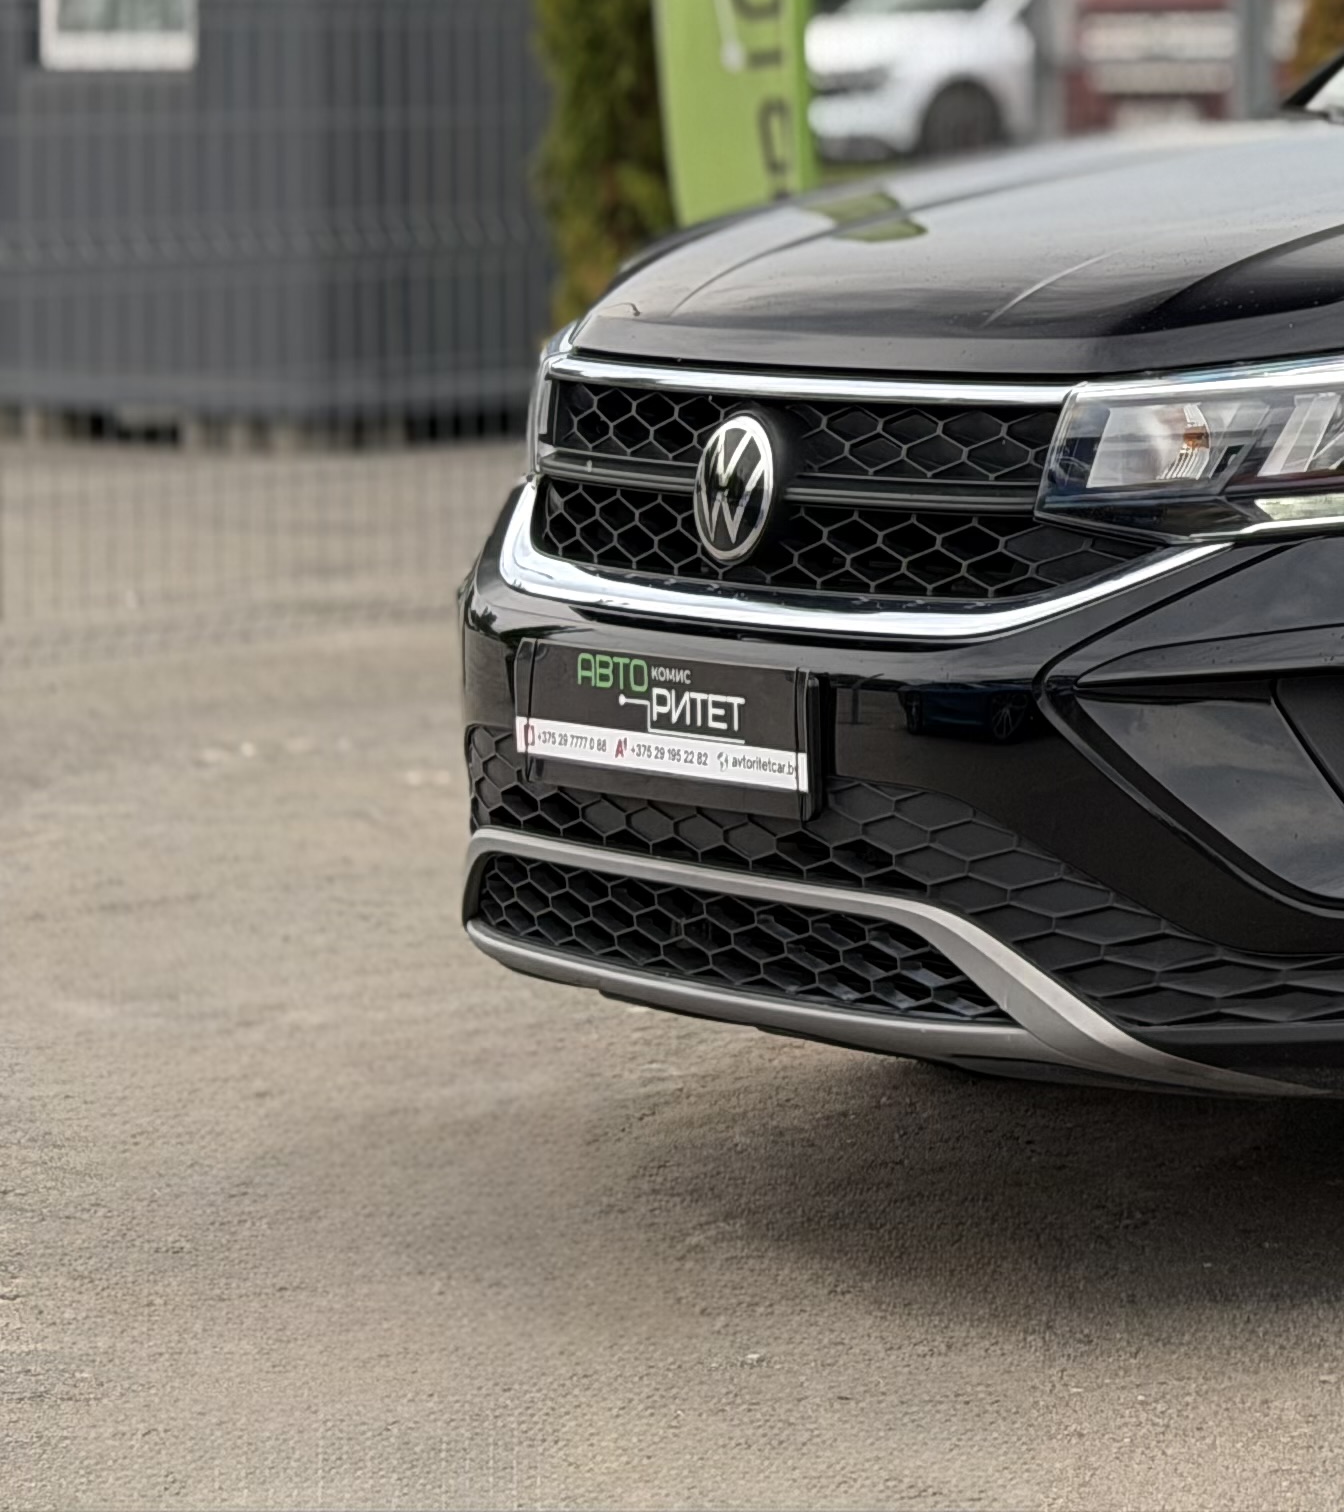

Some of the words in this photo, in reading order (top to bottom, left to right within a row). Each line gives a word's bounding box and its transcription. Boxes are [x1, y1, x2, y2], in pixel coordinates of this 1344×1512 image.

[577, 651, 649, 693] АВТО
[651, 687, 746, 732] РИТЕТ
[537, 730, 557, 746] +375
[631, 743, 652, 759] +375
[654, 745, 666, 761] 29
[667, 747, 682, 763] 195
[683, 749, 695, 765] 22
[696, 751, 709, 767] 82
